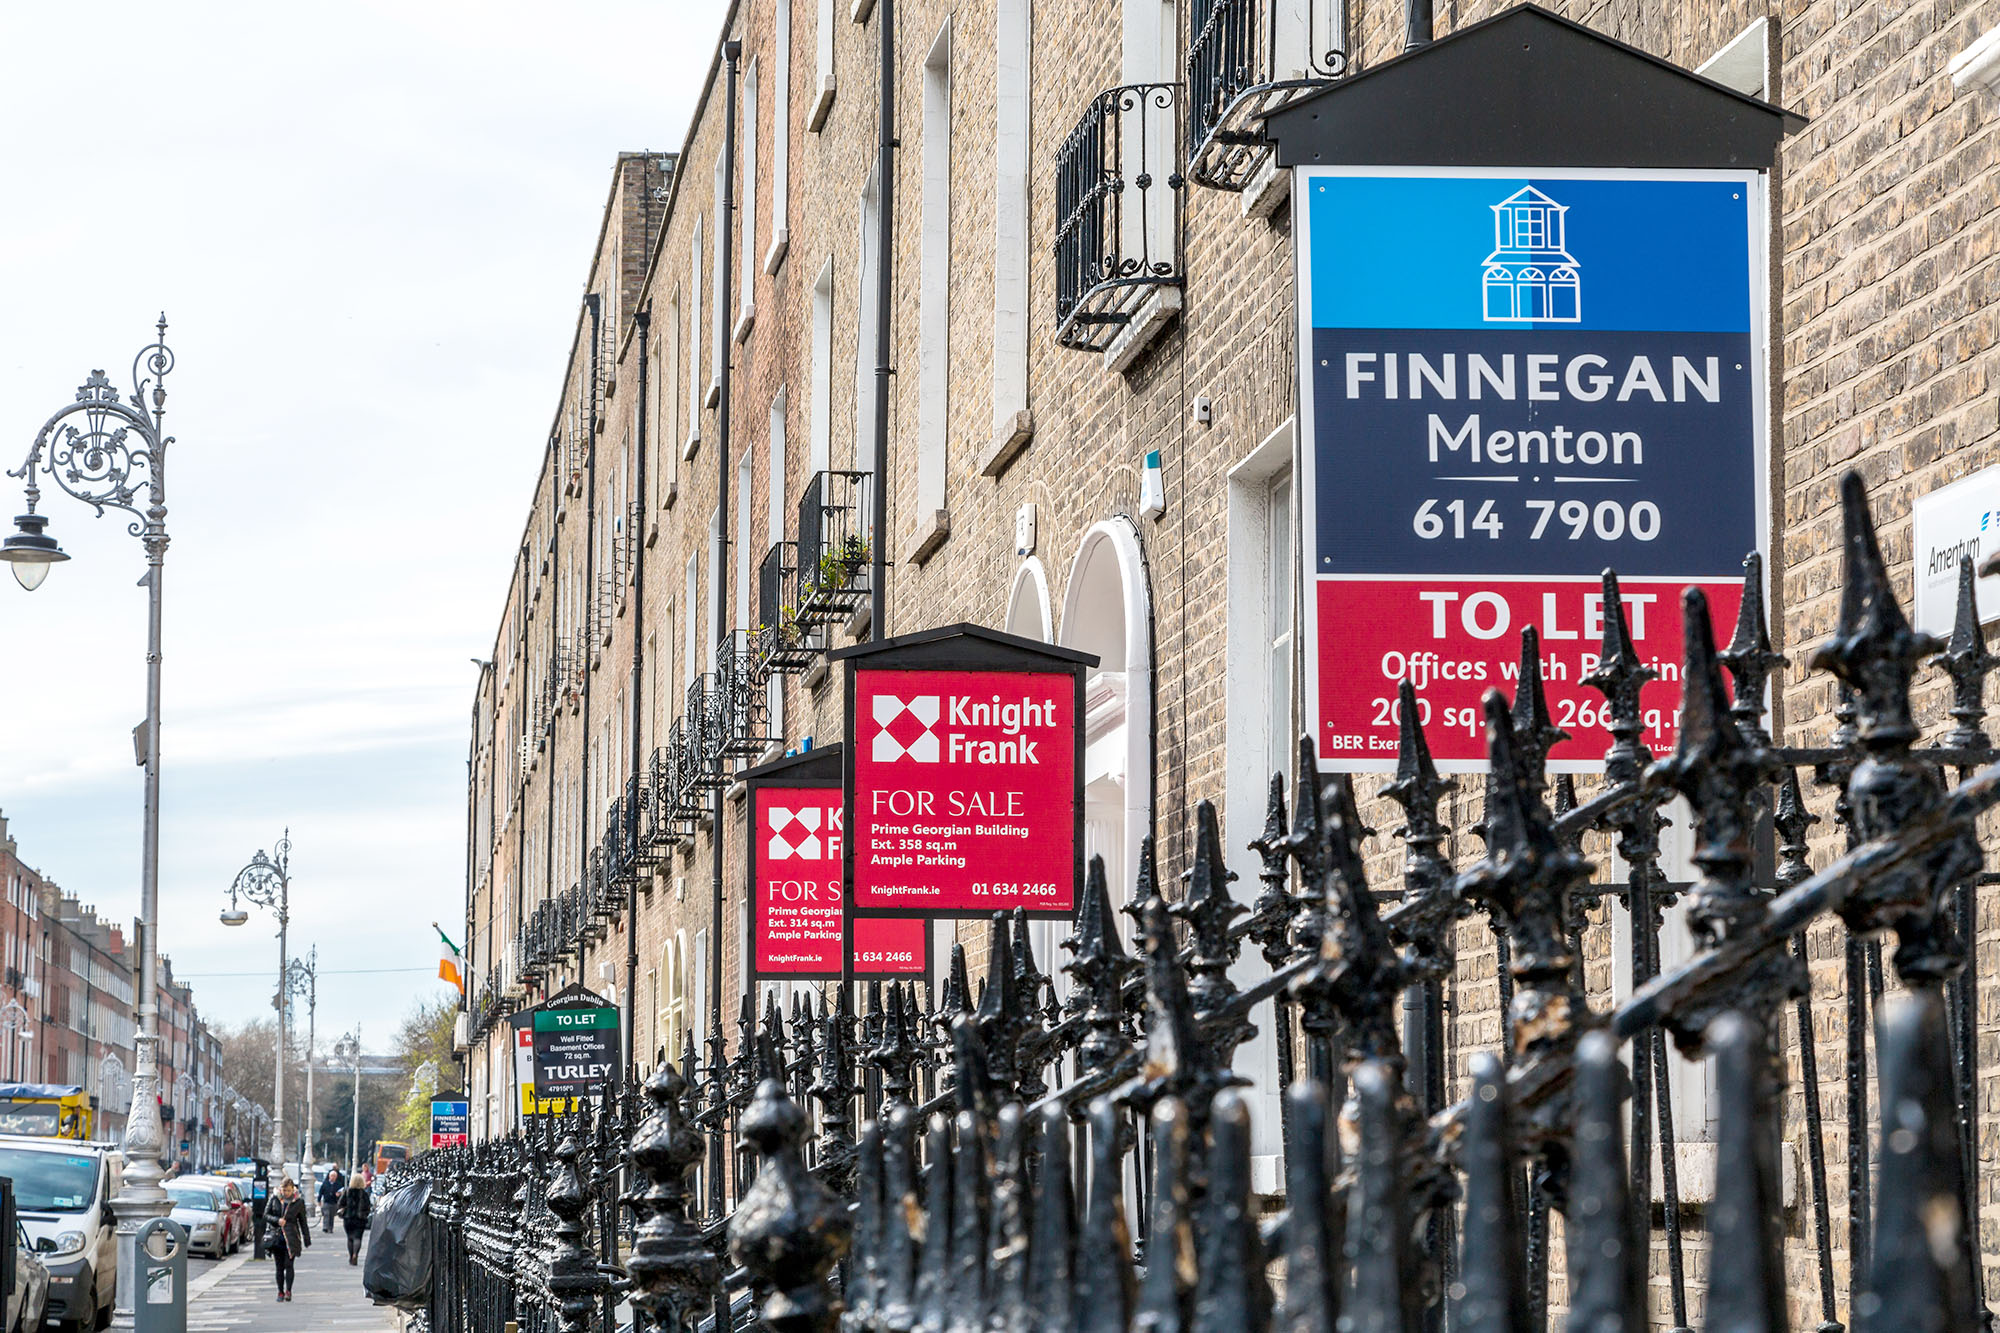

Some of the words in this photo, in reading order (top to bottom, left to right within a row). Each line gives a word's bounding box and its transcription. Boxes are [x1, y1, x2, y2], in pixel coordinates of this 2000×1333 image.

[1345, 353, 1720, 402] FINNEGAN
[1428, 413, 1642, 464] Menton
[1413, 499, 1503, 539] 614
[1525, 500, 1661, 541] 7900
[1928, 536, 1980, 576] Amentum
[1419, 591, 1510, 640] TO
[1543, 592, 1657, 640] LET
[1381, 651, 1487, 690] Offices
[1499, 653, 1567, 680] wth
[949, 695, 1057, 735] Knight
[1558, 698, 1611, 728] 266
[949, 733, 1039, 764] Frank
[1332, 735, 1364, 750] BER
[872, 790, 936, 816] FOR
[948, 790, 1025, 817] SALE
[871, 824, 909, 835] Prime
[912, 824, 972, 838] Georgian
[975, 825, 1029, 838] Building
[871, 840, 895, 850] Ext.
[899, 840, 922, 850] 358
[926, 841, 957, 852] sq.m
[871, 854, 913, 867] Ample
[917, 855, 966, 868] Parking
[768, 880, 818, 901] FOR
[871, 885, 940, 897] KnightFrank.ie
[972, 883, 991, 895] 01
[992, 883, 1018, 896] 634
[1023, 883, 1057, 896] 2466
[768, 906, 799, 916] Prime
[768, 919, 787, 928] Ext.
[790, 919, 808, 928] 314
[810, 920, 835, 930] sq.m
[768, 930, 801, 941] Ample
[804, 930, 842, 942] Parking
[768, 954, 823, 963] KnightFrank.ie
[862, 951, 883, 962] 634
[885, 952, 912, 962] 2466
[546, 994, 579, 1009] Georgian
[580, 993, 604, 1007] Dublin
[556, 1015, 572, 1026] TO
[575, 1014, 596, 1025] LET
[560, 1035, 575, 1043] Well
[575, 1034, 594, 1042] Fitted
[550, 1044, 582, 1052] Basement
[582, 1043, 605, 1051] Offices
[564, 1052, 573, 1060] 72
[543, 1063, 612, 1080] TURLEY
